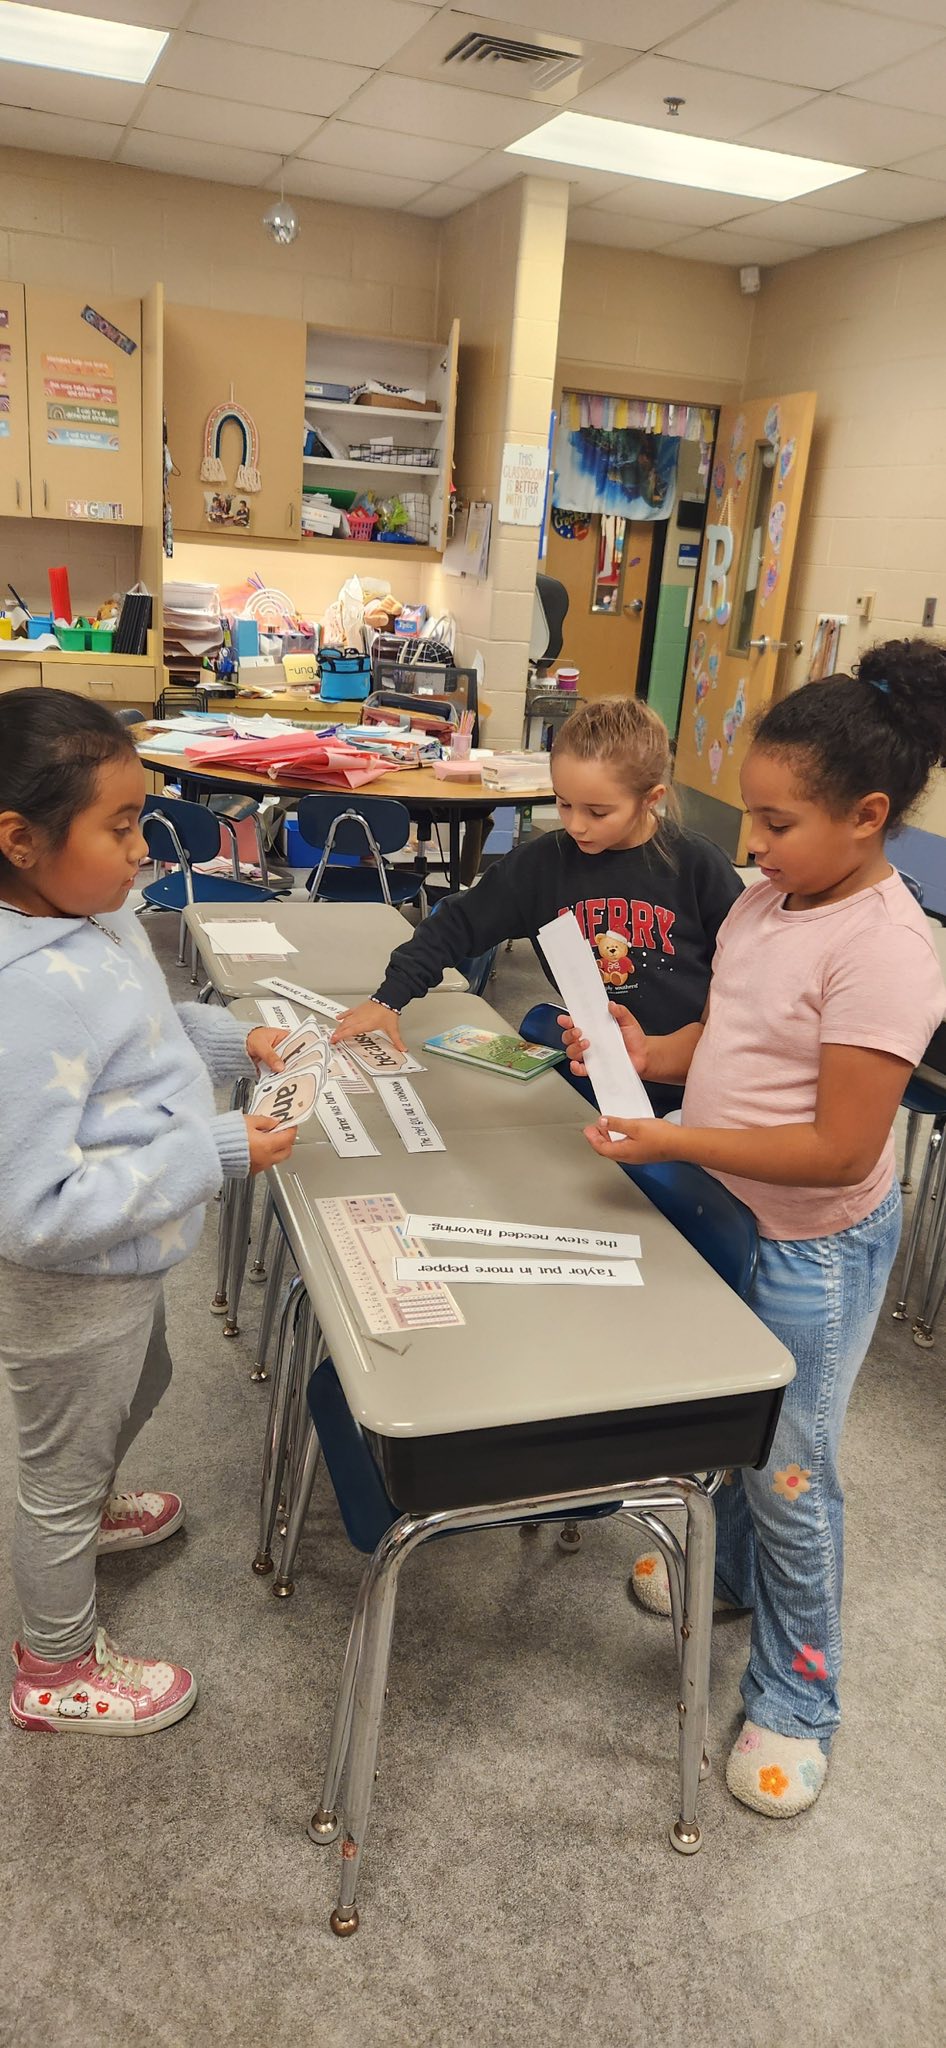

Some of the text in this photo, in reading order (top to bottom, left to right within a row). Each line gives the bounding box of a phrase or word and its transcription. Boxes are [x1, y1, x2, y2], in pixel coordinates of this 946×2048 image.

[66, 411, 116, 424] different strategy
[518, 452, 534, 466] THIS
[503, 465, 545, 481] CLASSROOM
[506, 479, 539, 495] IS BETTER
[506, 494, 539, 508] WITH YOU
[513, 507, 529, 520] IN IT
[698, 524, 734, 626] R
[289, 666, 315, 679] -ung
[392, 1081, 409, 1102] cookbook
[330, 1105, 343, 1117] was
[404, 1108, 416, 1116] out
[336, 1116, 352, 1131] dinner
[409, 1117, 423, 1125] got
[344, 1132, 358, 1143] Our
[411, 1126, 428, 1137] chef
[420, 1137, 433, 1147] The
[428, 1223, 618, 1248] the stew needed flavoring.
[417, 1264, 469, 1273] pepper
[519, 1267, 532, 1276] in
[538, 1265, 562, 1275] put
[569, 1266, 616, 1278] Taylor
